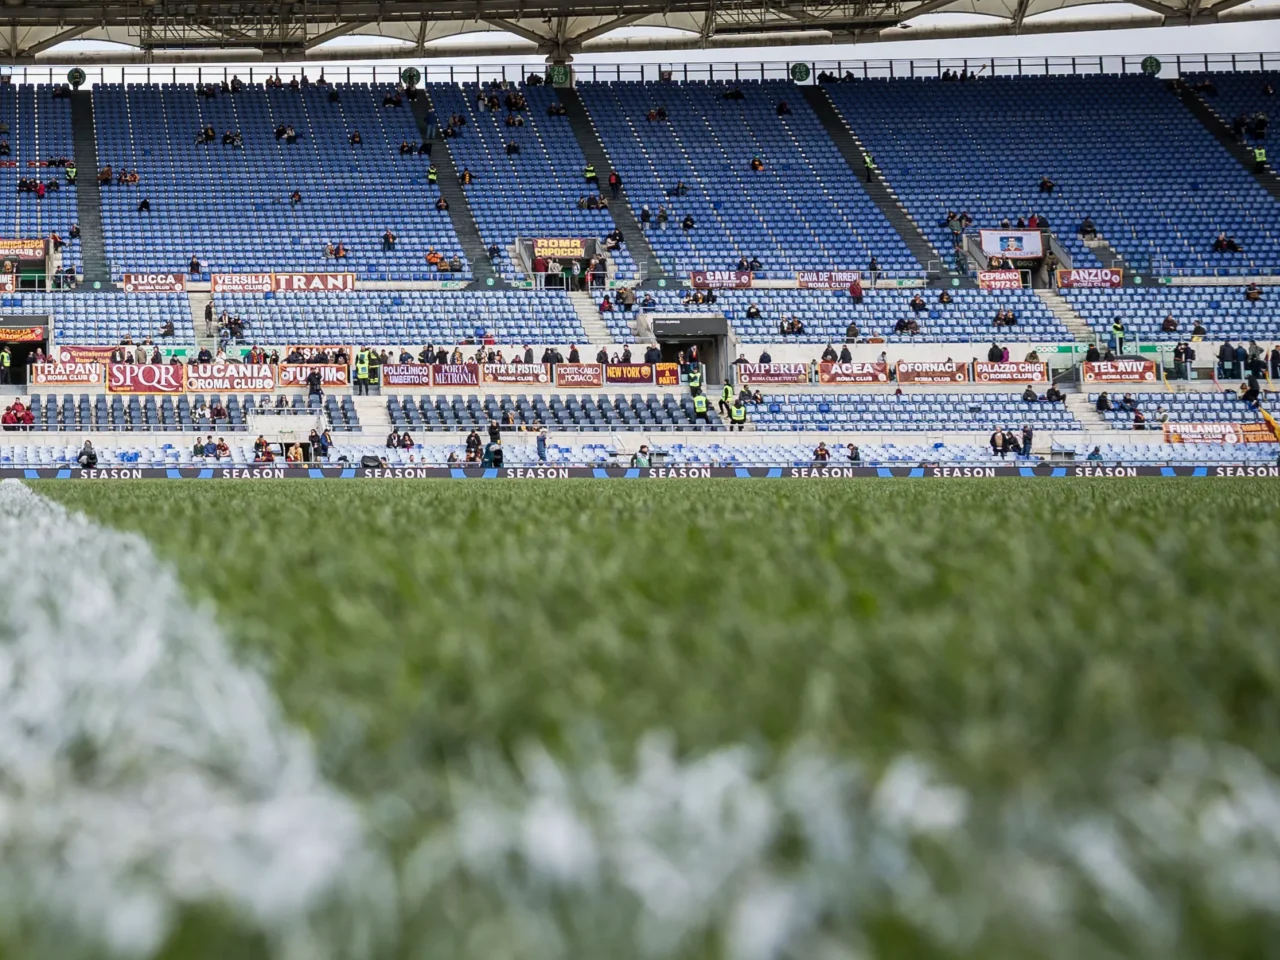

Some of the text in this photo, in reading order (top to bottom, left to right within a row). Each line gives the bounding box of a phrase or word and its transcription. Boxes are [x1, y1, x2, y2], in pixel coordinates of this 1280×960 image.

[534, 248, 584, 256] CAPOCCIA
[131, 275, 175, 284] LUCCA
[706, 271, 736, 280] CAVE
[800, 272, 859, 281] CAVA DE' TIRRENI
[980, 272, 1019, 280] CEPRANO
[1070, 270, 1111, 280] ANZIO
[216, 276, 271, 284] VERSILIA
[276, 276, 353, 289] TRANI
[35, 363, 99, 374] TRAPANI
[188, 364, 272, 377] LUCANIA
[442, 365, 468, 373] PORTA
[484, 364, 546, 374] CITTA' DI PISTOIA
[740, 364, 805, 374] IMPERIA
[831, 364, 874, 374] ACEA
[908, 363, 956, 372] FORNACI
[978, 364, 1016, 372] PALAZZO
[1092, 362, 1144, 372] TEL AVIV
[607, 367, 640, 377] NEW YORK
[112, 365, 180, 390] SPQR
[435, 373, 477, 384] METRONIA
[199, 379, 263, 389] ROMA CLUB
[1169, 425, 1234, 433] FINLANDIA
[81, 470, 141, 479] SEASON
[223, 469, 283, 478] SEASON
[365, 469, 426, 478] SEASON
[507, 469, 568, 478] SEASON
[650, 469, 710, 478] SEASON
[792, 468, 852, 477] SEASON
[934, 468, 994, 477] SEASON
[1076, 468, 1136, 477] SEASON
[1217, 468, 1278, 477] SEASON
